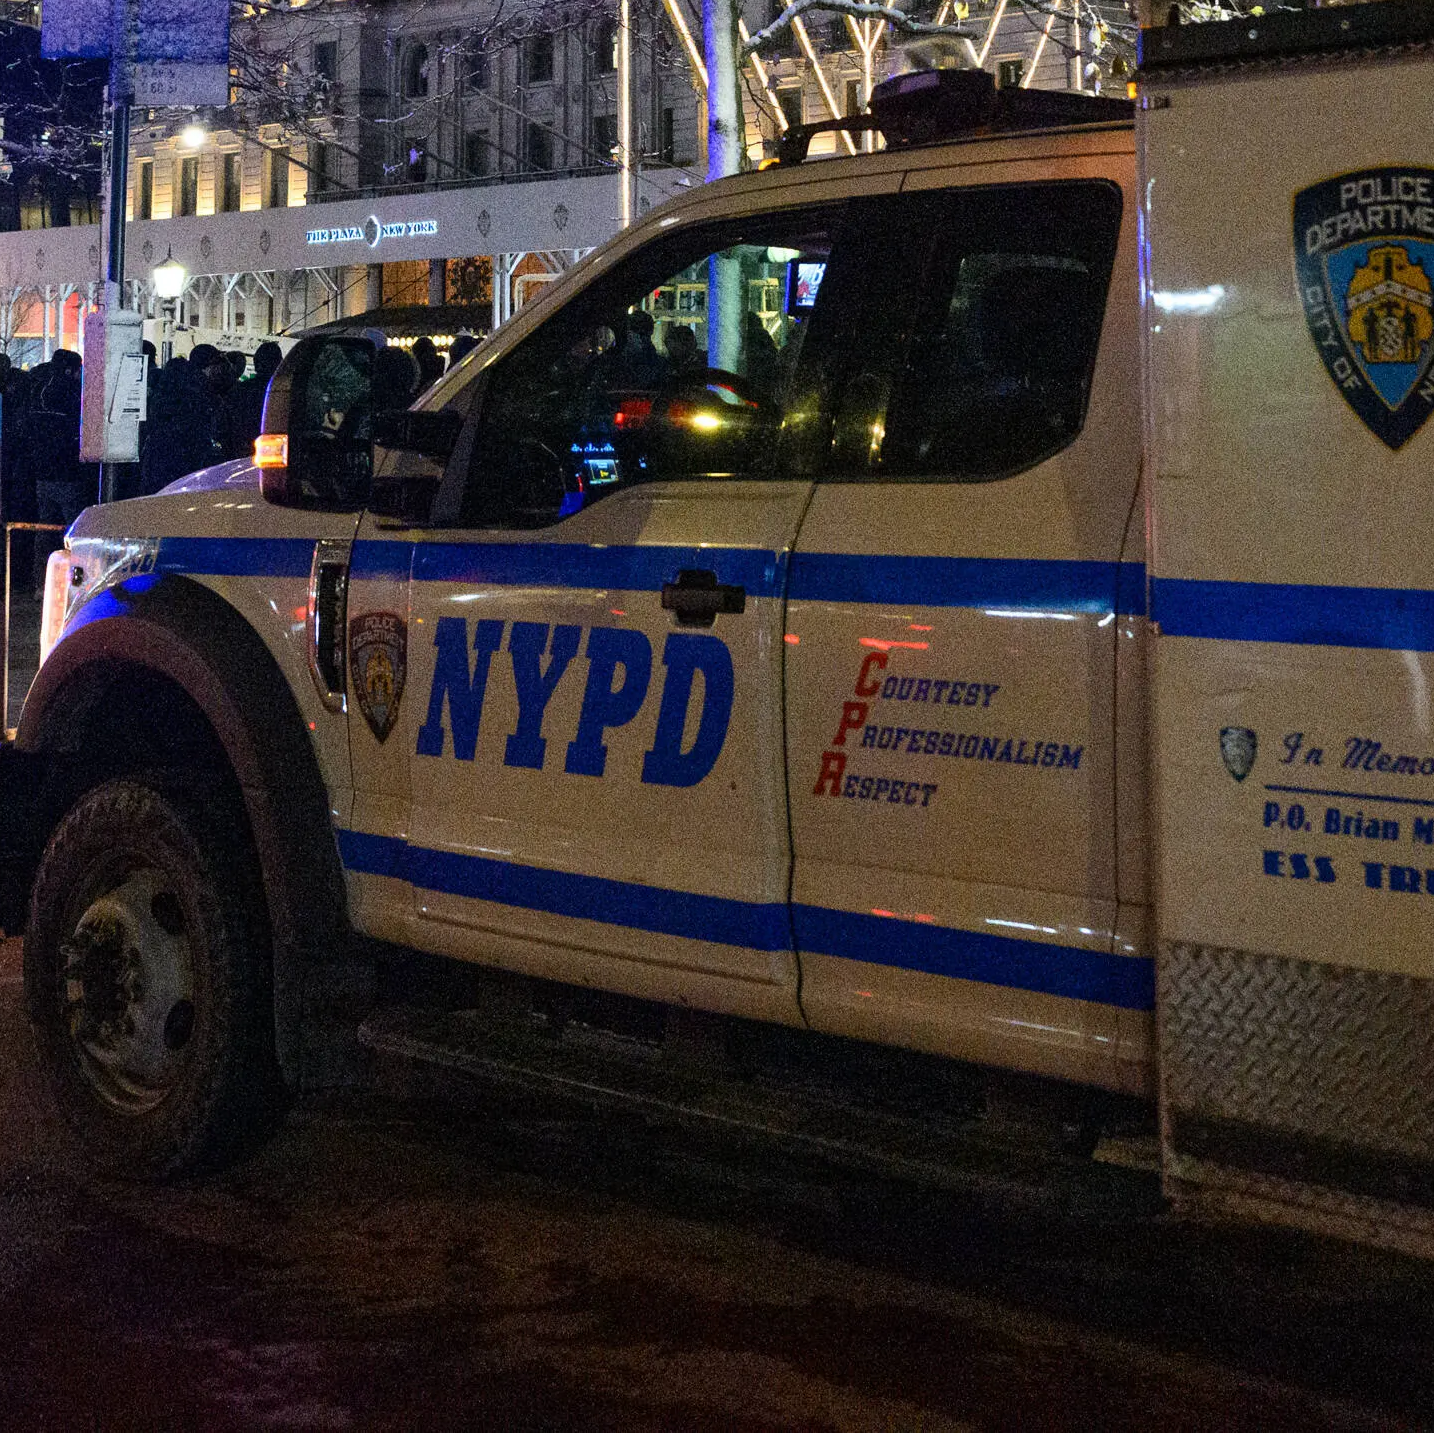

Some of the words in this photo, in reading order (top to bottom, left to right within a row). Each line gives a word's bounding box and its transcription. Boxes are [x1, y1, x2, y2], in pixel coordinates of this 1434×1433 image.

[1340, 176, 1433, 210] POLICE
[306, 229, 329, 244] THE
[329, 226, 365, 242] PLAZA
[381, 222, 406, 238] NEW
[406, 220, 438, 237] YORK
[1305, 286, 1339, 347] CITY
[1332, 357, 1363, 391] OF
[416, 616, 735, 788] NYPD
[854, 651, 1001, 708] COURTESY
[831, 701, 1085, 770] PROFESSIONALISM
[1279, 731, 1323, 766] In
[813, 750, 938, 808] RESPECT
[1262, 800, 1312, 832] P.O.
[1323, 807, 1400, 842] Brian
[1262, 848, 1337, 883] ESS
